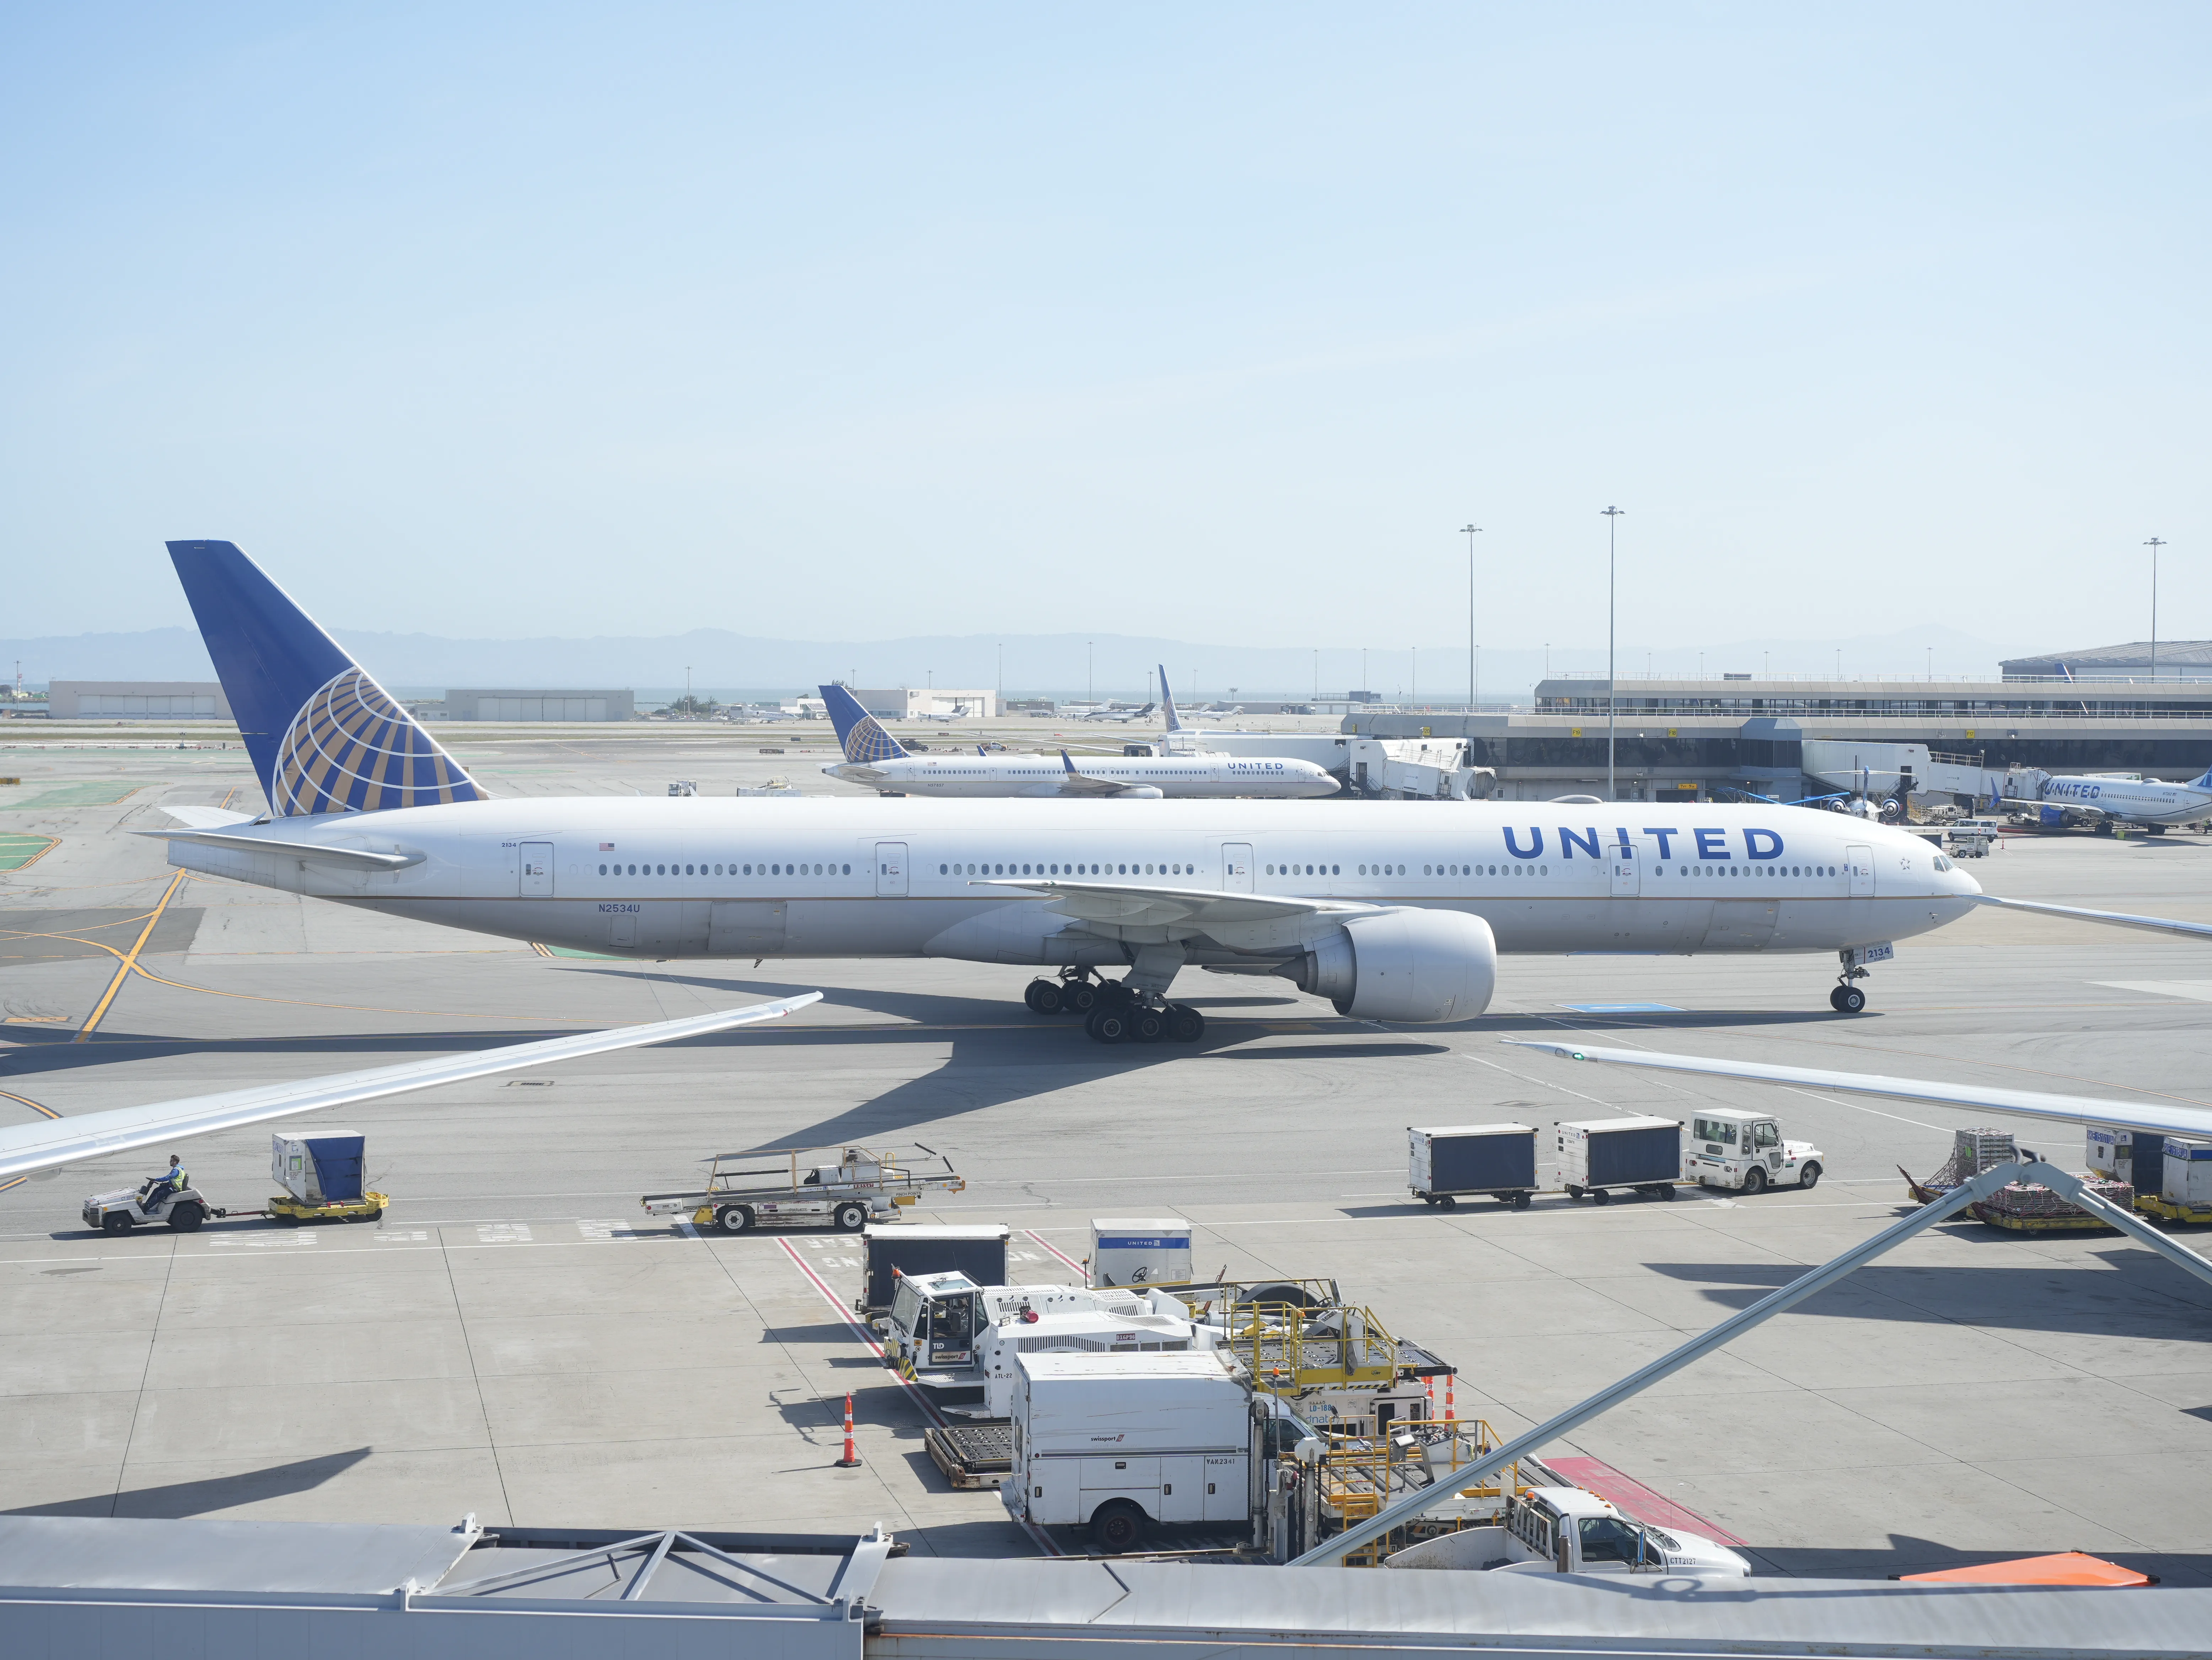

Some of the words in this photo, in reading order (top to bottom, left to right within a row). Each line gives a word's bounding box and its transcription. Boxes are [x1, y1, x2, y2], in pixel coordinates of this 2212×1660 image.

[2044, 782, 2100, 799] UNITED
[1502, 826, 1784, 860] UNITED
[599, 904, 640, 913] N2534U
[1868, 947, 1890, 958] 2134
[2096, 1133, 2108, 1143] 15101
[2108, 1136, 2114, 1144] UA
[209, 1231, 318, 1247] STOP
